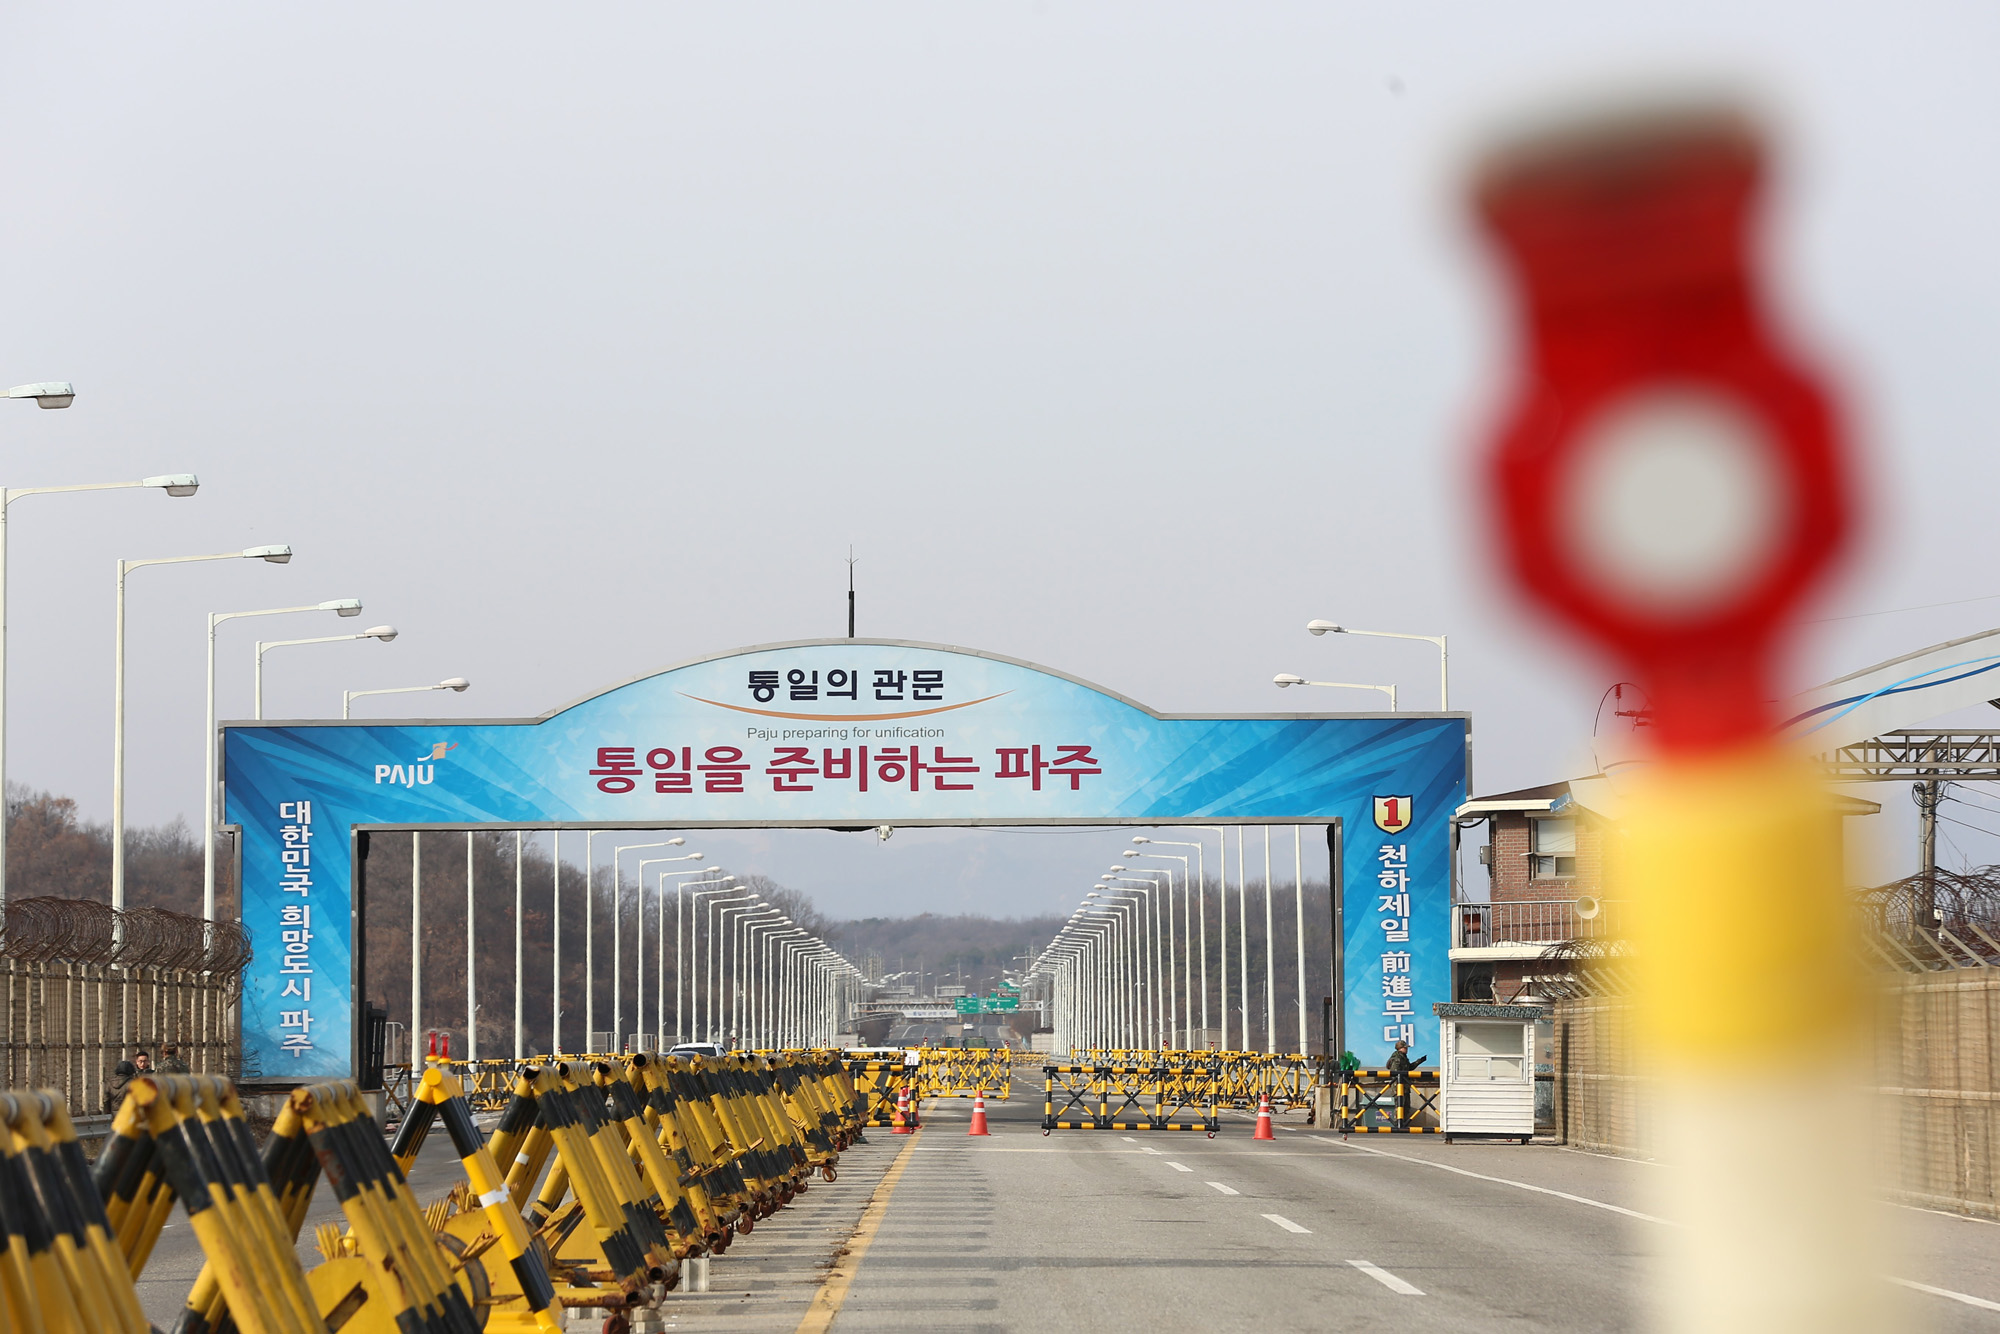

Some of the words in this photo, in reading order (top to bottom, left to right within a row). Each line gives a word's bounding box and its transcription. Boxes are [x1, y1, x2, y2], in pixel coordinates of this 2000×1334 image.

[747, 668, 858, 703] 통일의
[872, 669, 944, 701] 관문
[747, 727, 778, 741] Paju
[783, 727, 848, 741] preparing
[853, 726, 871, 738] for
[875, 726, 945, 738] unification
[375, 764, 434, 789] PAJU
[589, 745, 751, 794] 통일을
[765, 745, 980, 793] 준비하는
[994, 744, 1102, 791] 파주
[1383, 798, 1403, 827] 1
[279, 800, 314, 898] 대한민국
[1377, 844, 1411, 943] 천하제일
[279, 905, 314, 1002] 희망도시
[1380, 950, 1415, 1048] 前進부대
[279, 1008, 314, 1058] 파주
